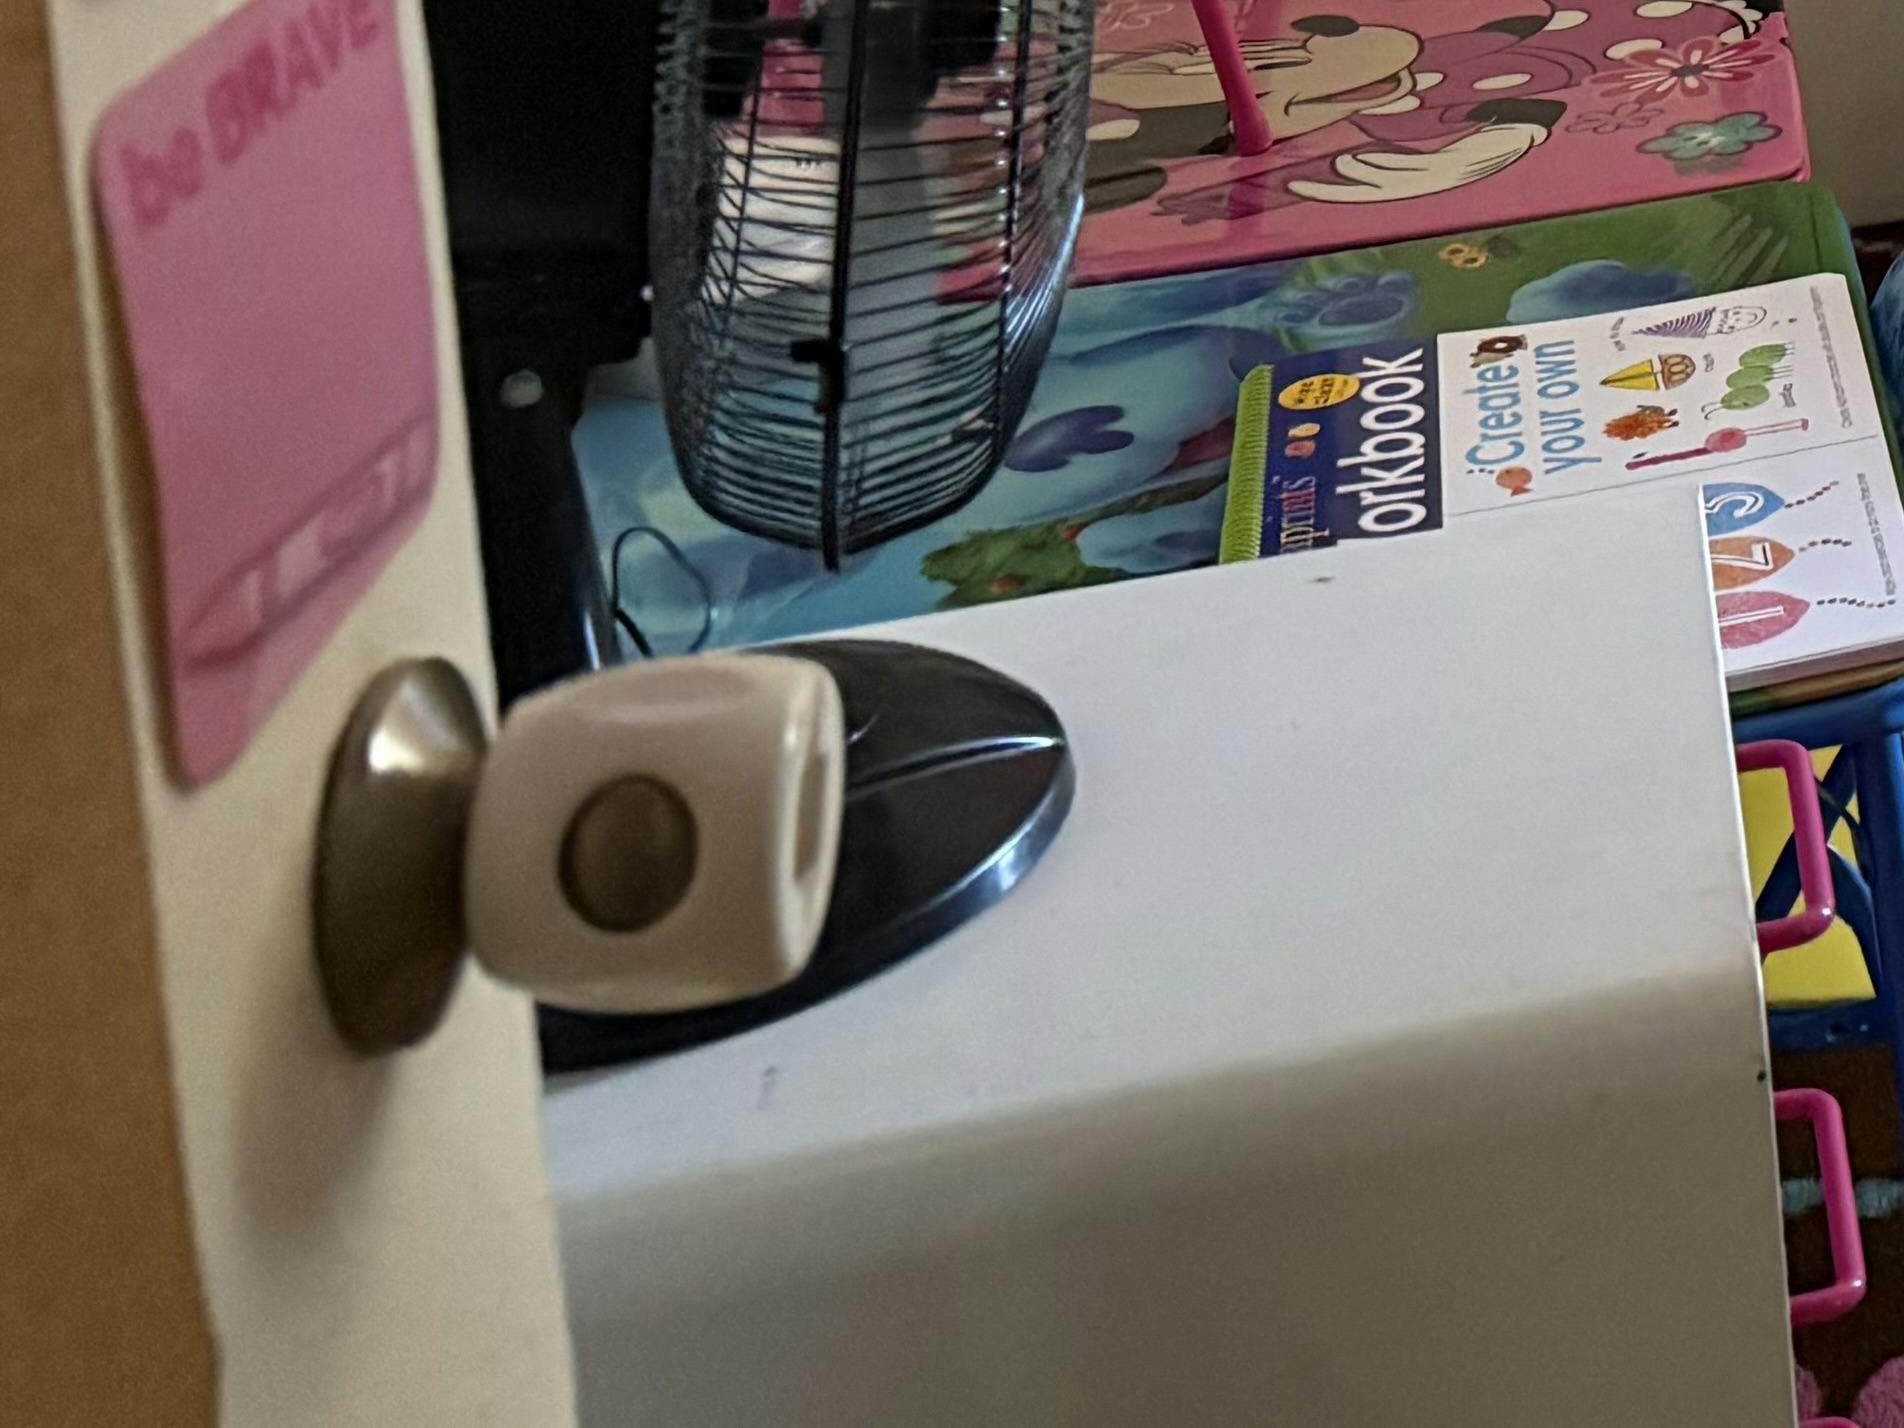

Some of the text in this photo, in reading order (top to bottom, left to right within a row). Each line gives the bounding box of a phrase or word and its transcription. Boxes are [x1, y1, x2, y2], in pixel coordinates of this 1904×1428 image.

[1336, 347, 1427, 534] orkbook
[1466, 362, 1524, 466] Create
[1534, 340, 1601, 475] your own
